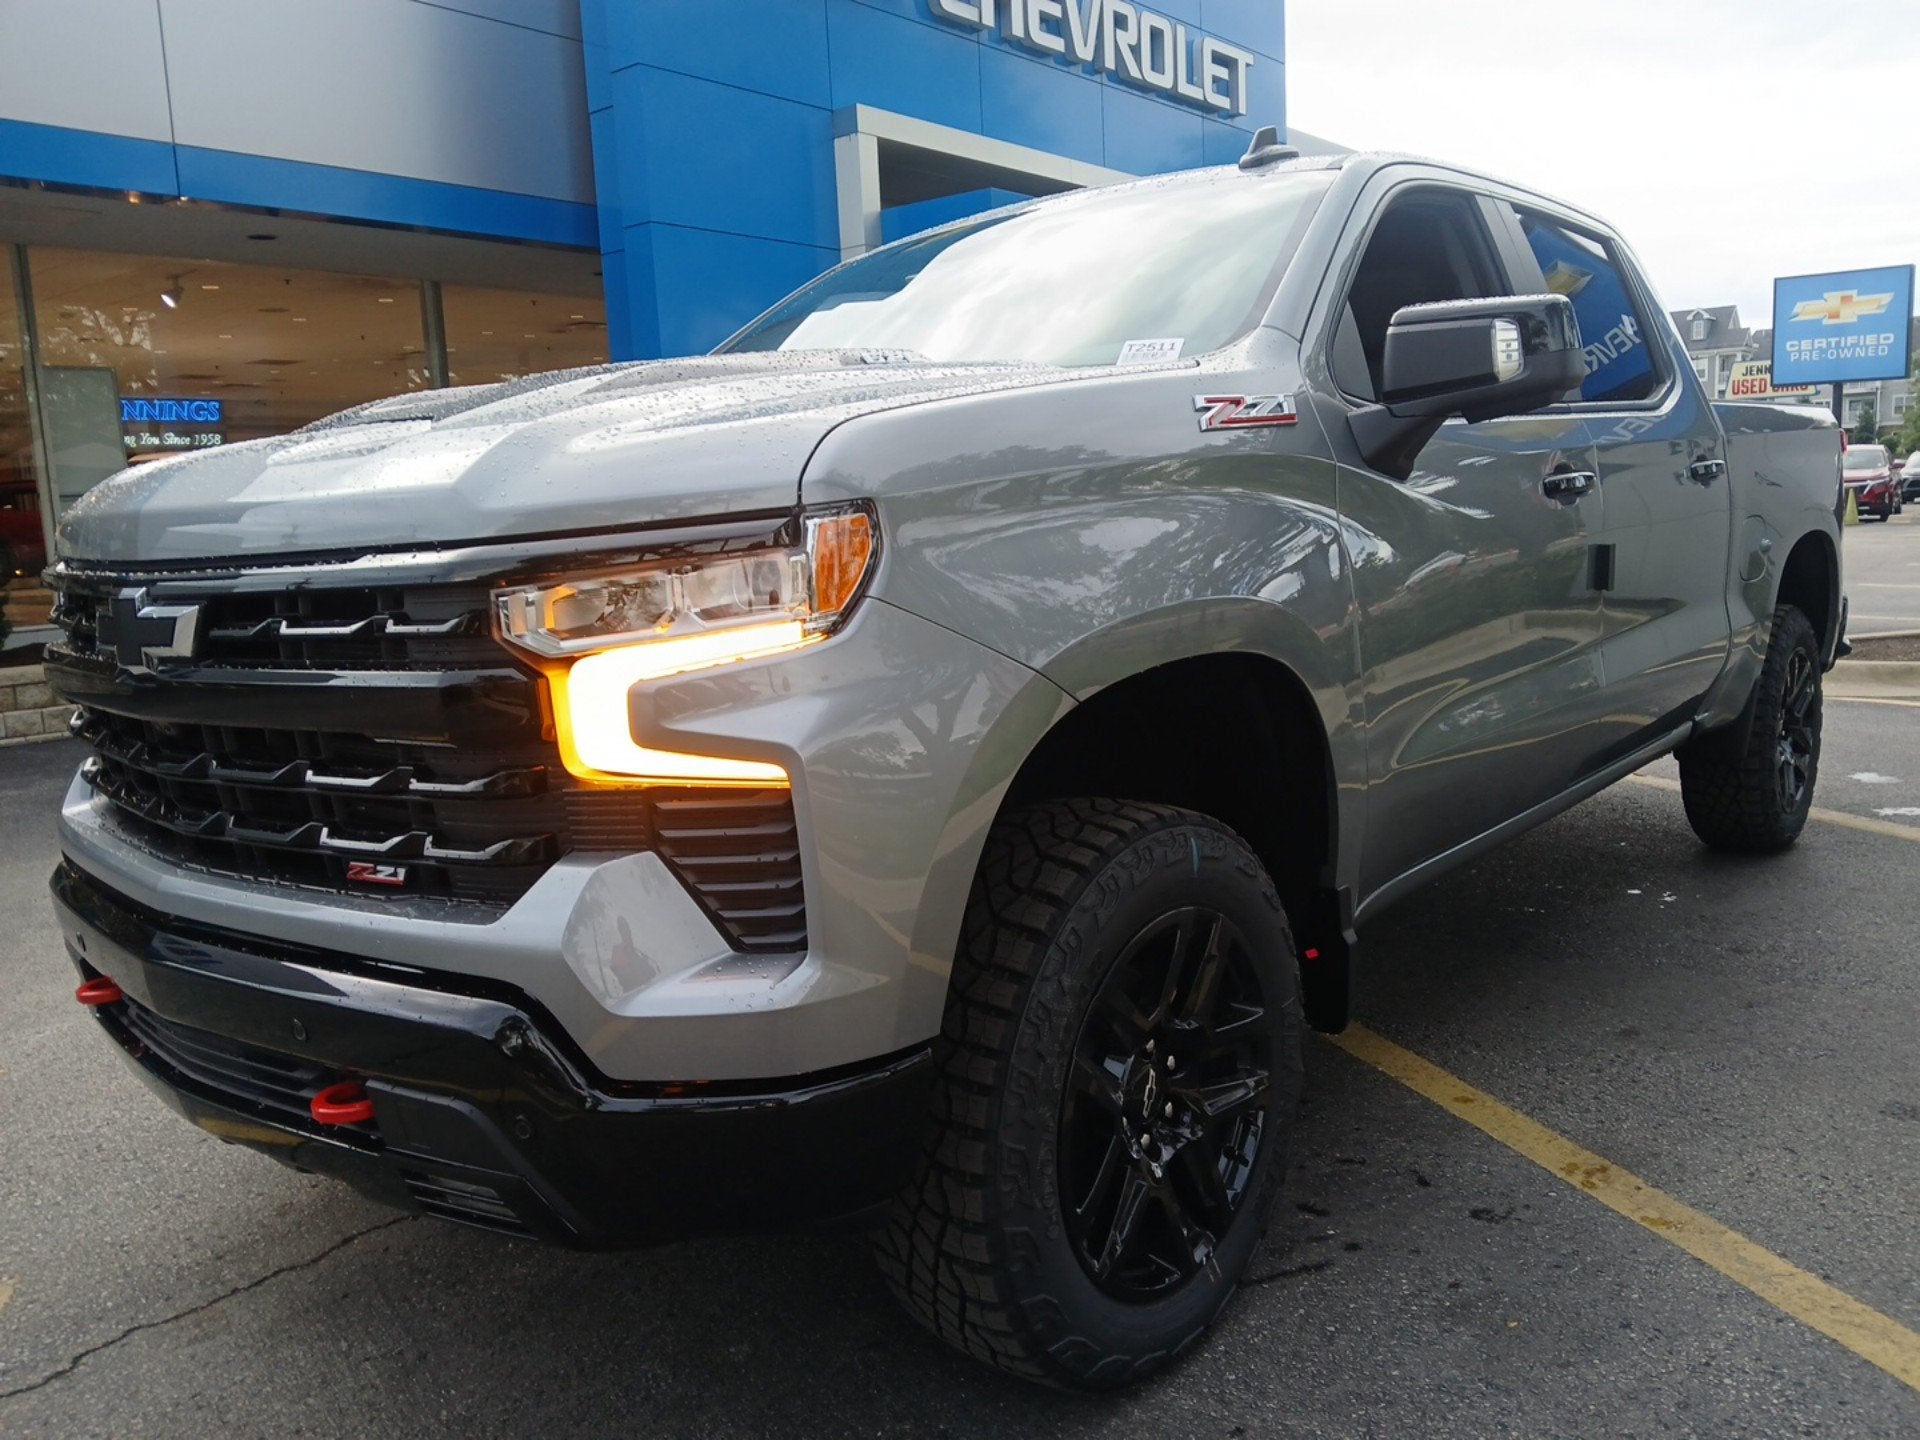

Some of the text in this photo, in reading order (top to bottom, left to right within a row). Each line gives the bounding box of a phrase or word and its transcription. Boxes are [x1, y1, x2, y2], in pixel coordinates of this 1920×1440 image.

[936, 0, 1254, 116] EVROLET
[1786, 333, 1894, 351] CERTIFIED
[1790, 345, 1888, 361] PRE-OWNED
[1731, 378, 1768, 395] USED
[1193, 393, 1298, 432] Z71
[139, 432, 160, 445] You
[163, 432, 191, 445] Since
[194, 433, 221, 445] 1958
